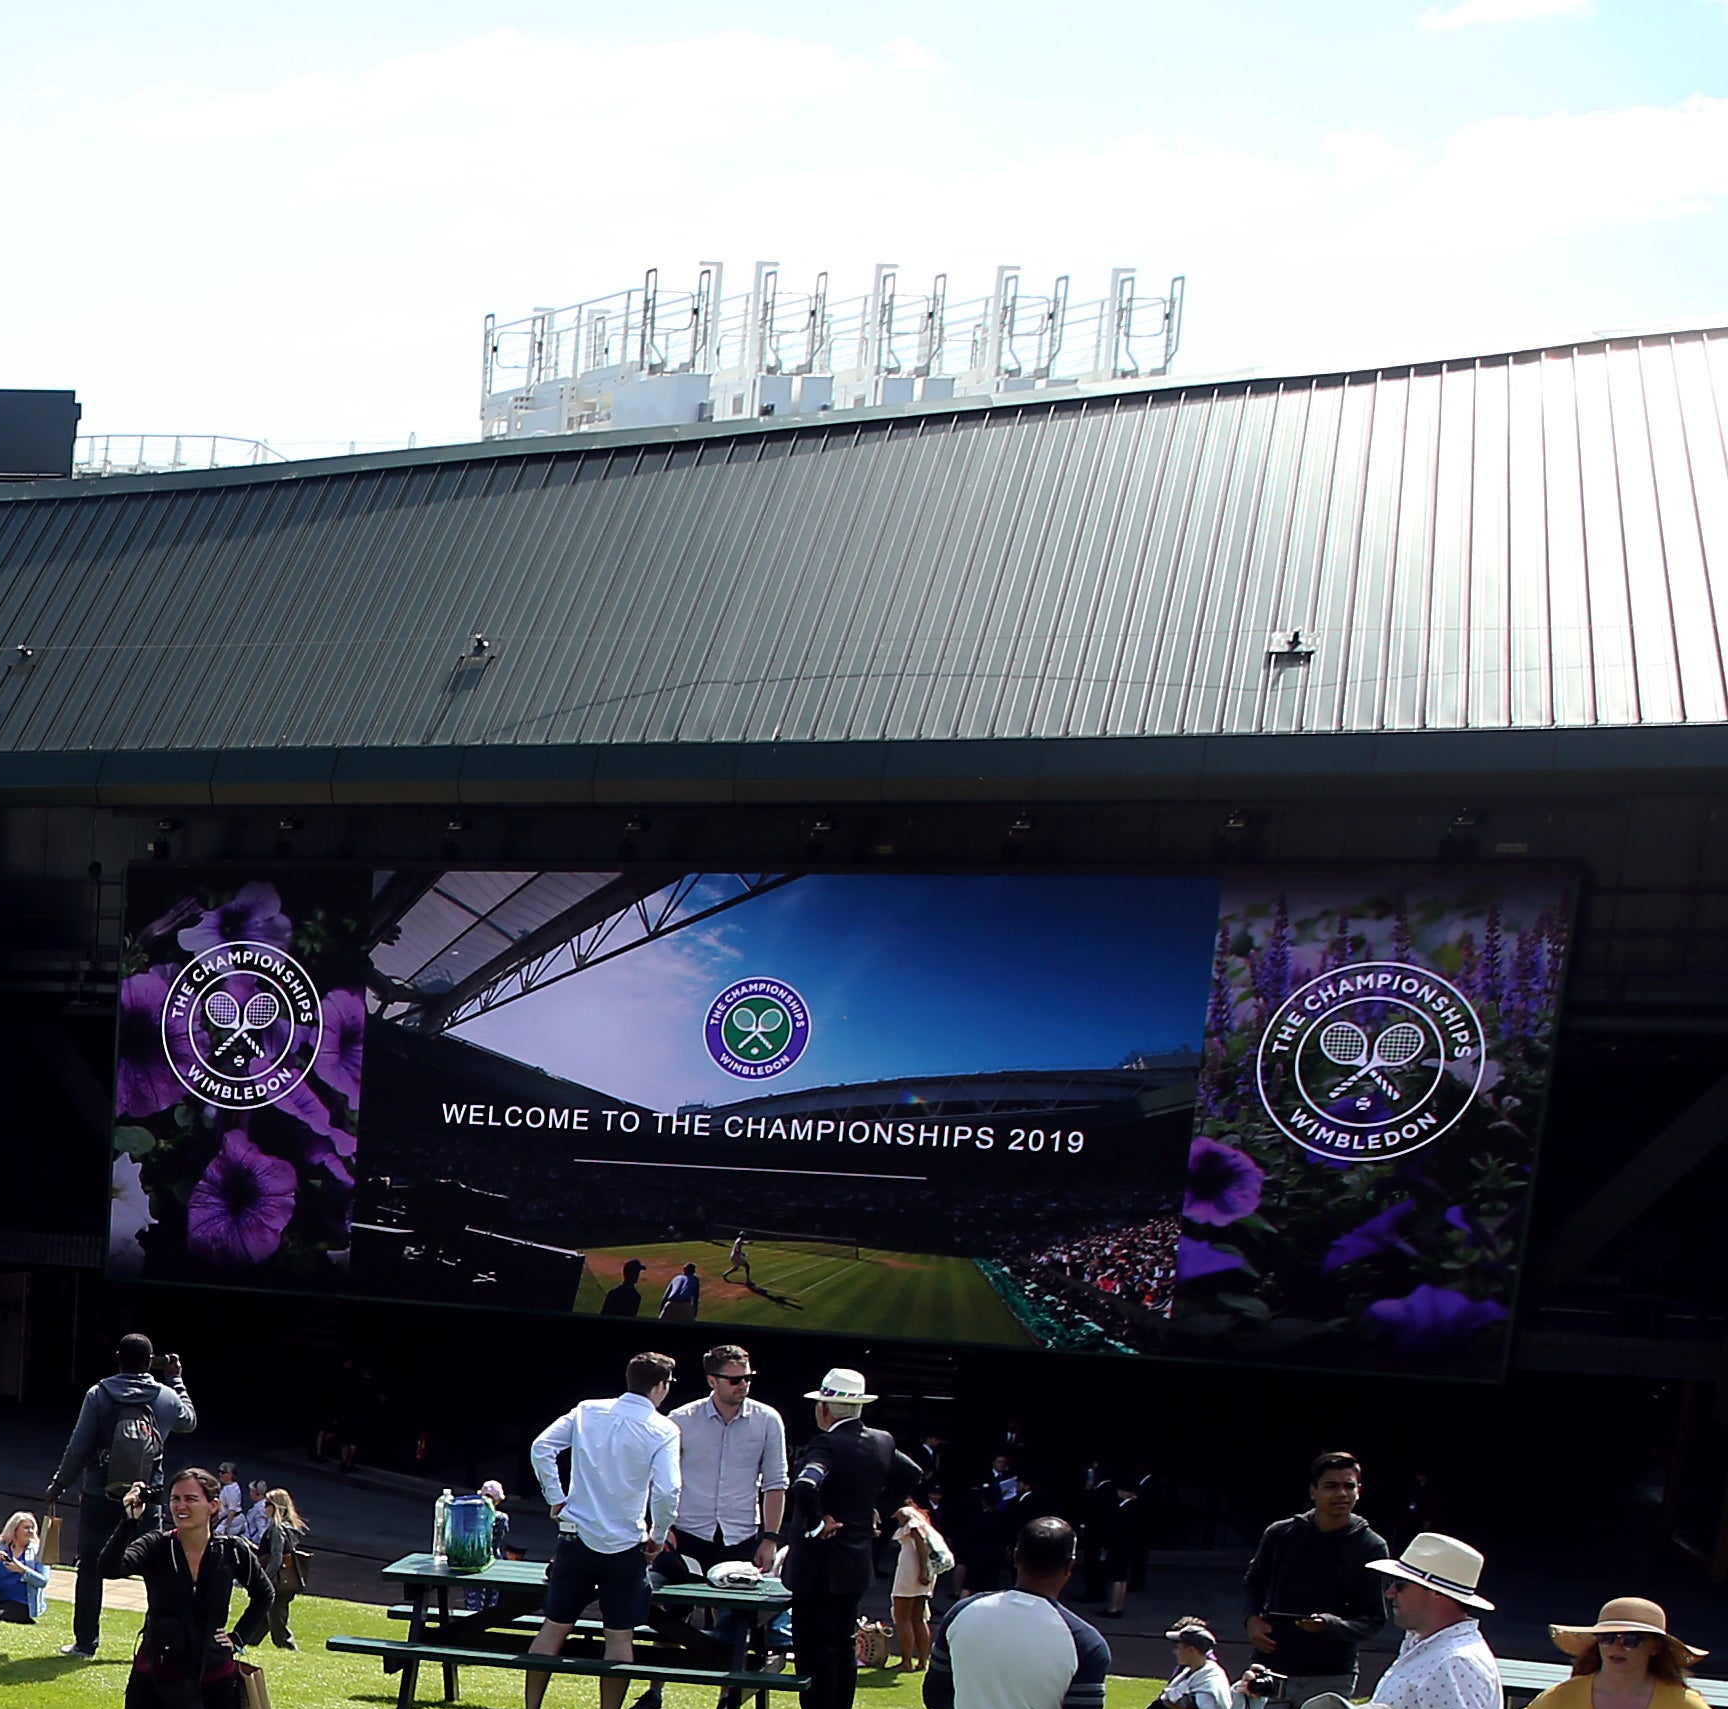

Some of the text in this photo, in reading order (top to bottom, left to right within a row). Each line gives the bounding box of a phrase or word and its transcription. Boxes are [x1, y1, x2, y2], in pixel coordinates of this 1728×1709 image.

[172, 951, 313, 1022] THE CHAMPIONSHIPS
[710, 983, 805, 1028] THE CHAMPIONSHIPS
[1272, 973, 1471, 1058] THE CHAMPIONSHIPS
[188, 1063, 292, 1100] WIMBLEDON
[719, 1052, 791, 1075] WIMBLEDON
[442, 1103, 1085, 1153] WELCOME TO THE CHAMPIONSHIPS 2019
[1289, 1107, 1438, 1150] WIMBLEDON
